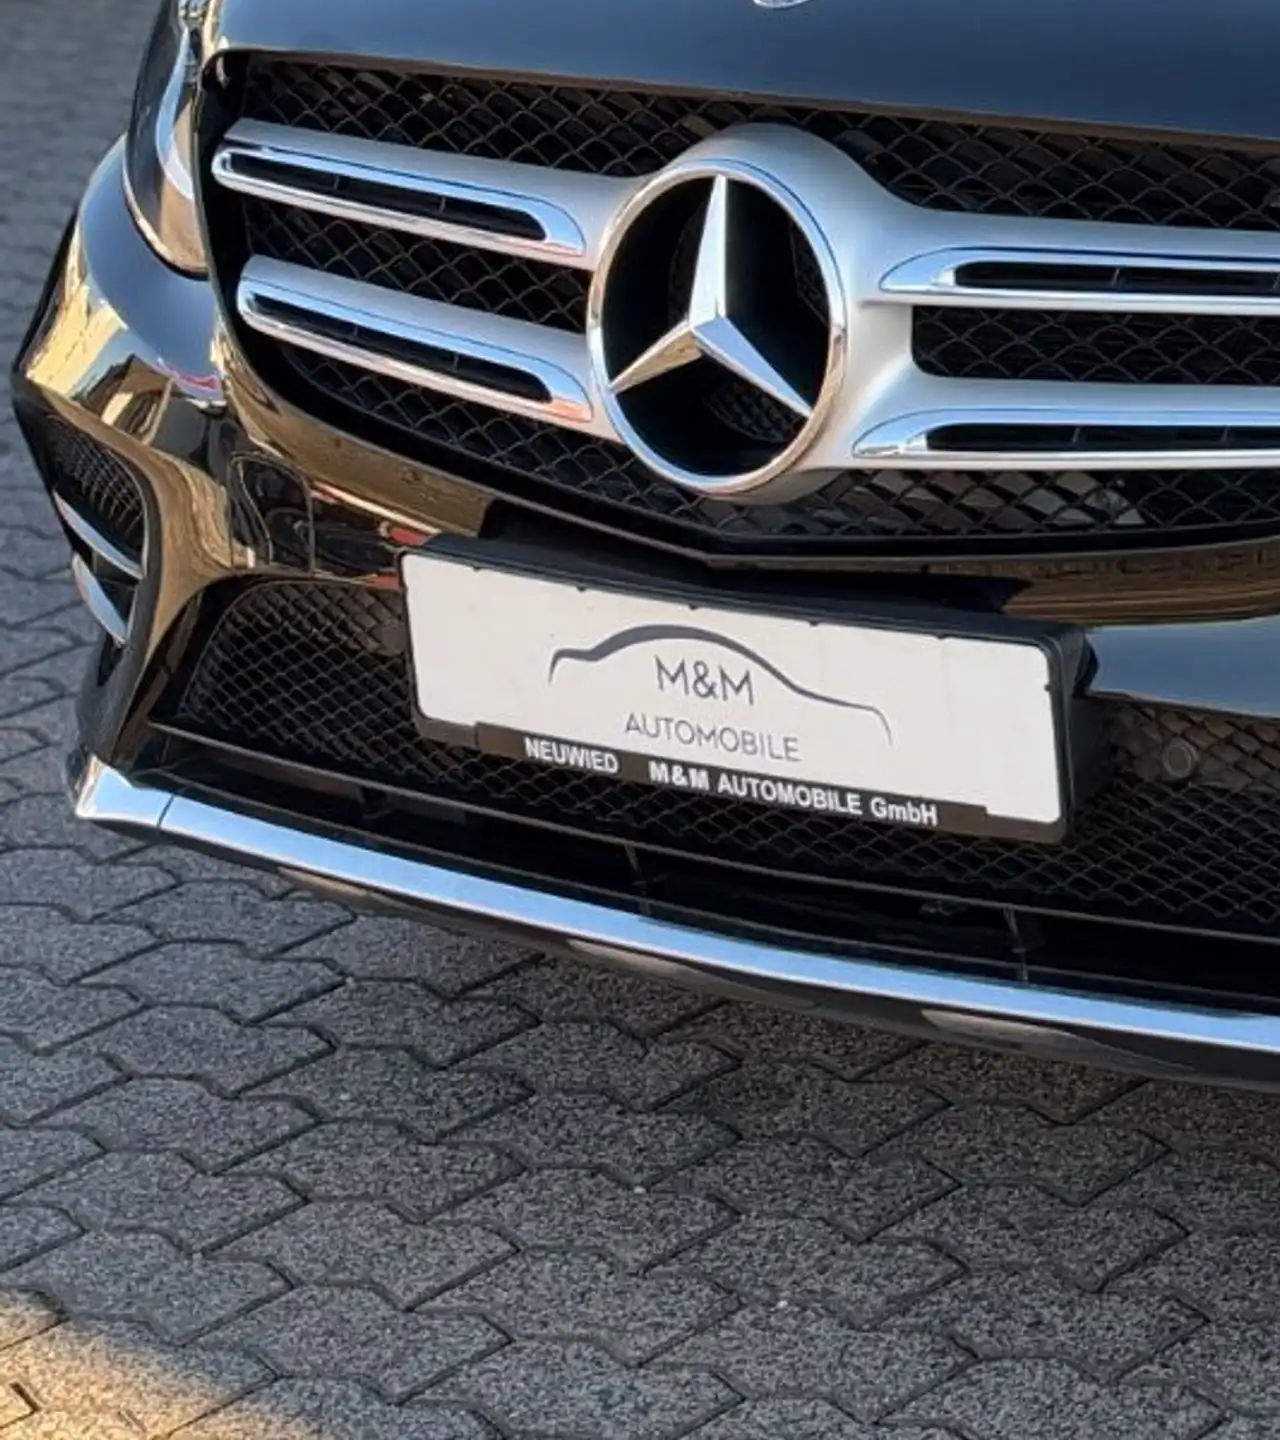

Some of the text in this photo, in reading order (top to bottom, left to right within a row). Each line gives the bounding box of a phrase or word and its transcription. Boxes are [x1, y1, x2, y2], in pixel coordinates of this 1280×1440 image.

[654, 654, 755, 706] M&M
[624, 712, 803, 762] AUTOMOBILE
[523, 736, 938, 827] NEUWIED M&M AUTOMOBILE GmbH
